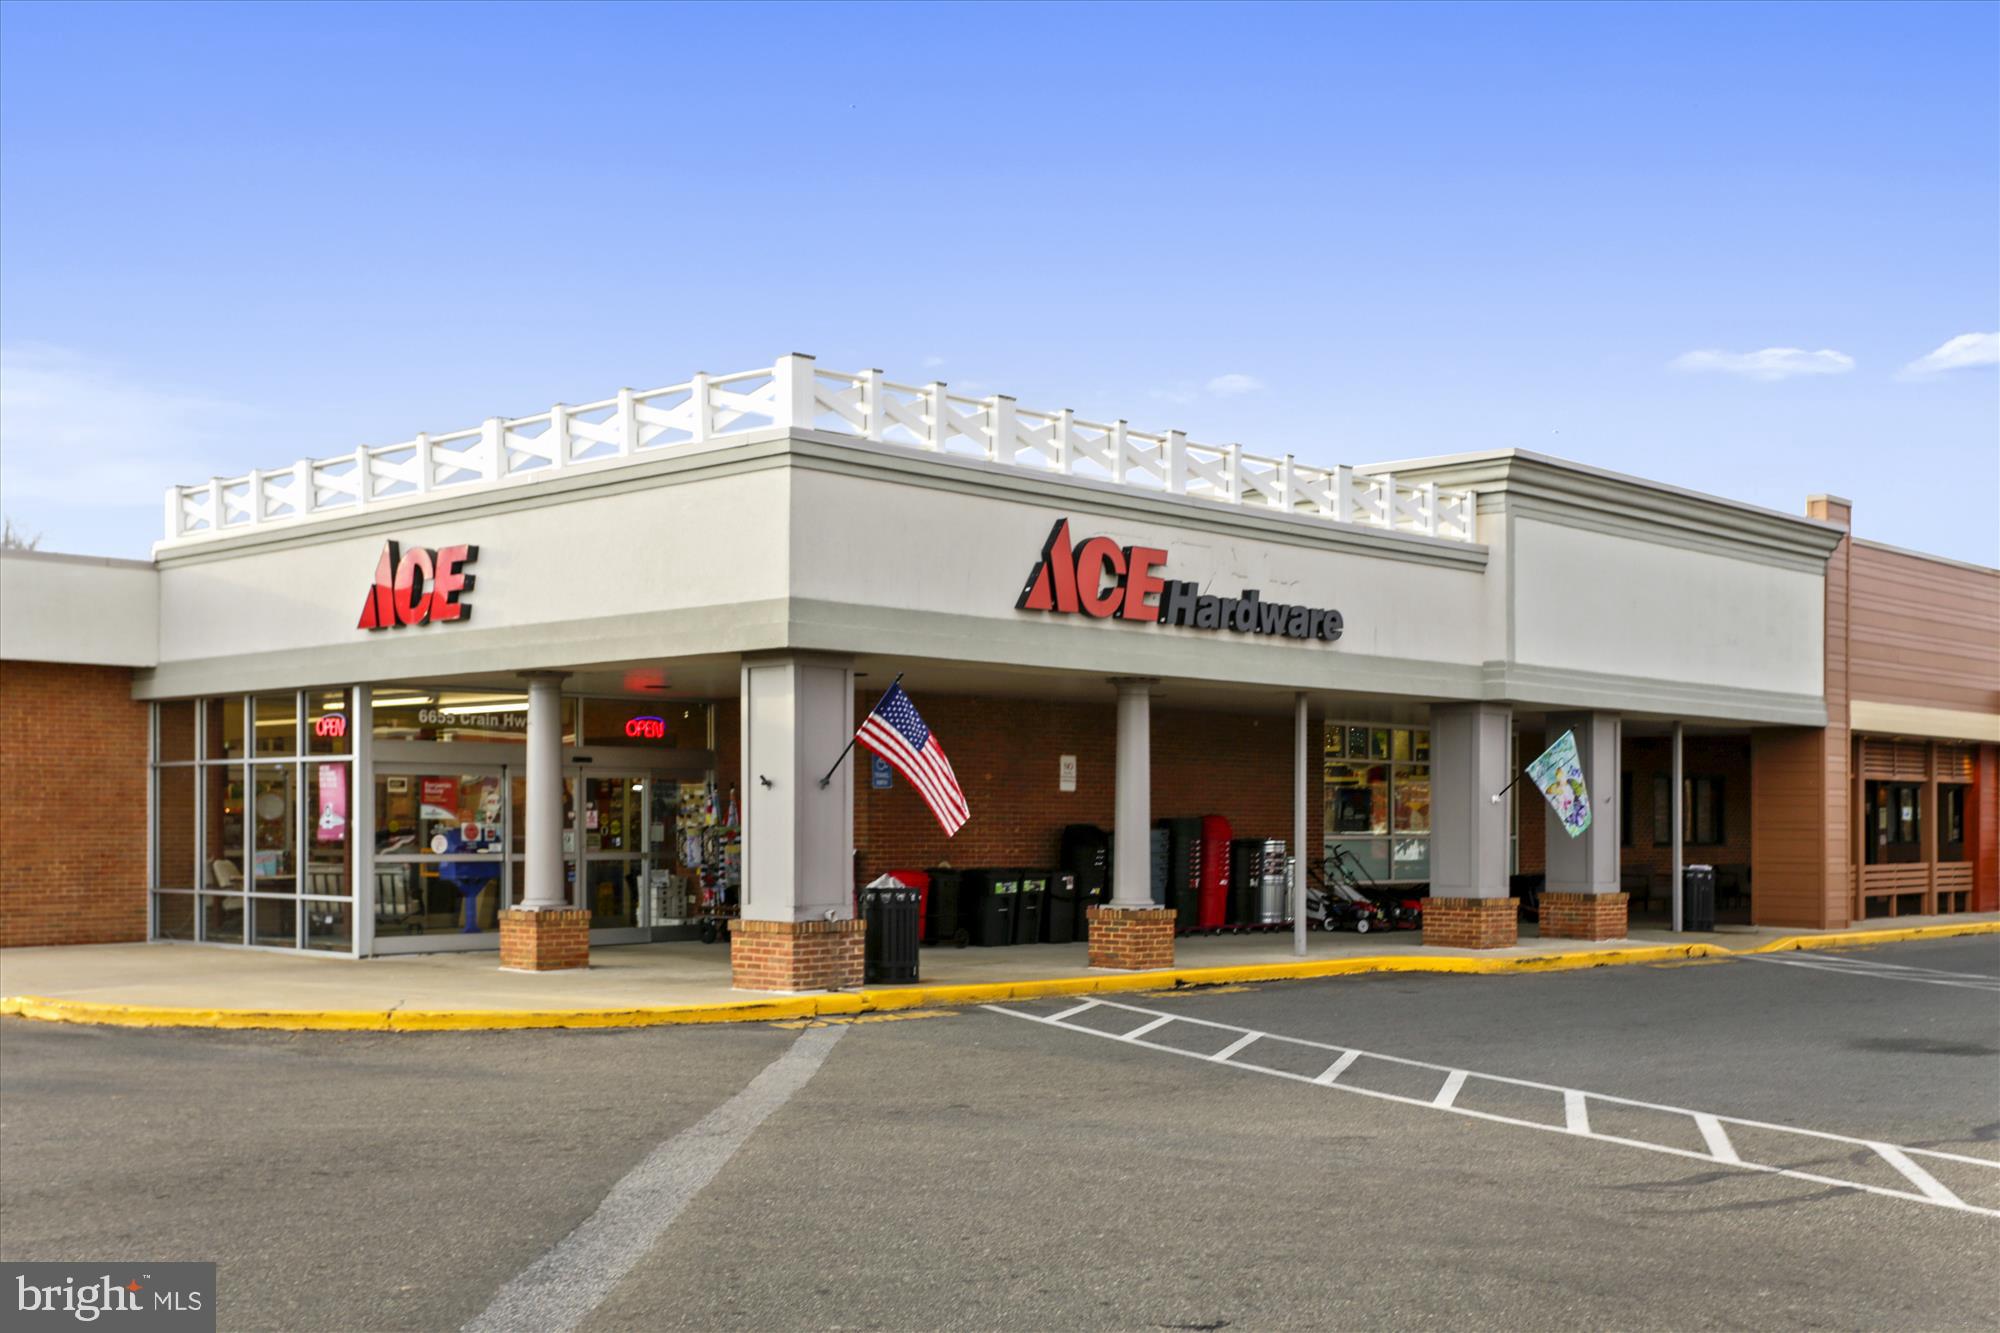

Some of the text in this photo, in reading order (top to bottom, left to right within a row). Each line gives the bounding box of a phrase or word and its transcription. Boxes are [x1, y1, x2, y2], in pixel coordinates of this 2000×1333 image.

[357, 539, 479, 630] ACE
[1015, 517, 1344, 641] ACE Hardware
[315, 716, 347, 736] OPEN
[418, 709, 528, 729] 6655 Crain Hw
[624, 719, 665, 739] OPEN
